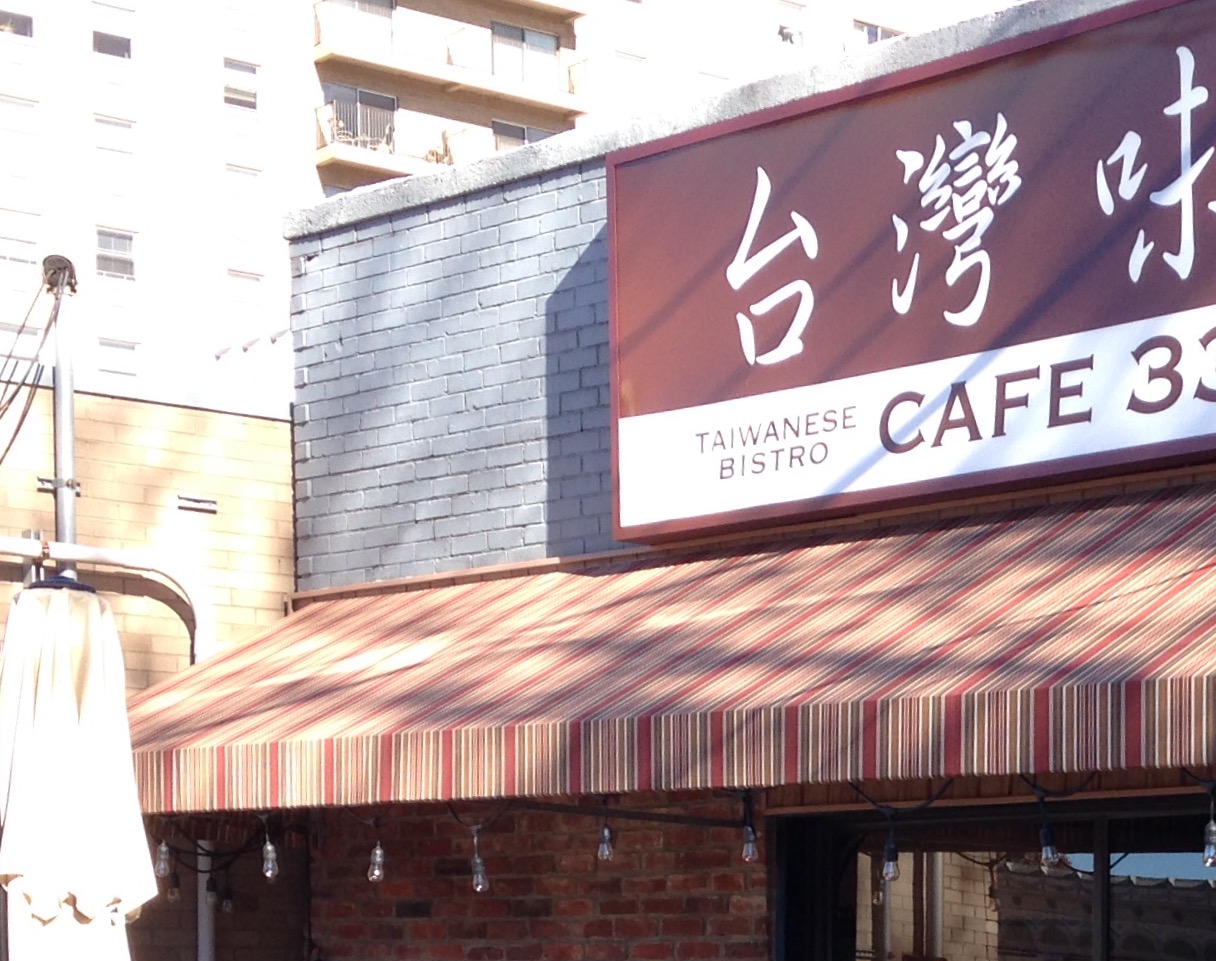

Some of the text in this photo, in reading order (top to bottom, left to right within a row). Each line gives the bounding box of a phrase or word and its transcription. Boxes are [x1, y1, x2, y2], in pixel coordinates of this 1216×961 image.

[879, 354, 1094, 454] CAFE
[695, 405, 857, 453] TAIWANESE
[719, 441, 829, 480] BISTRO
